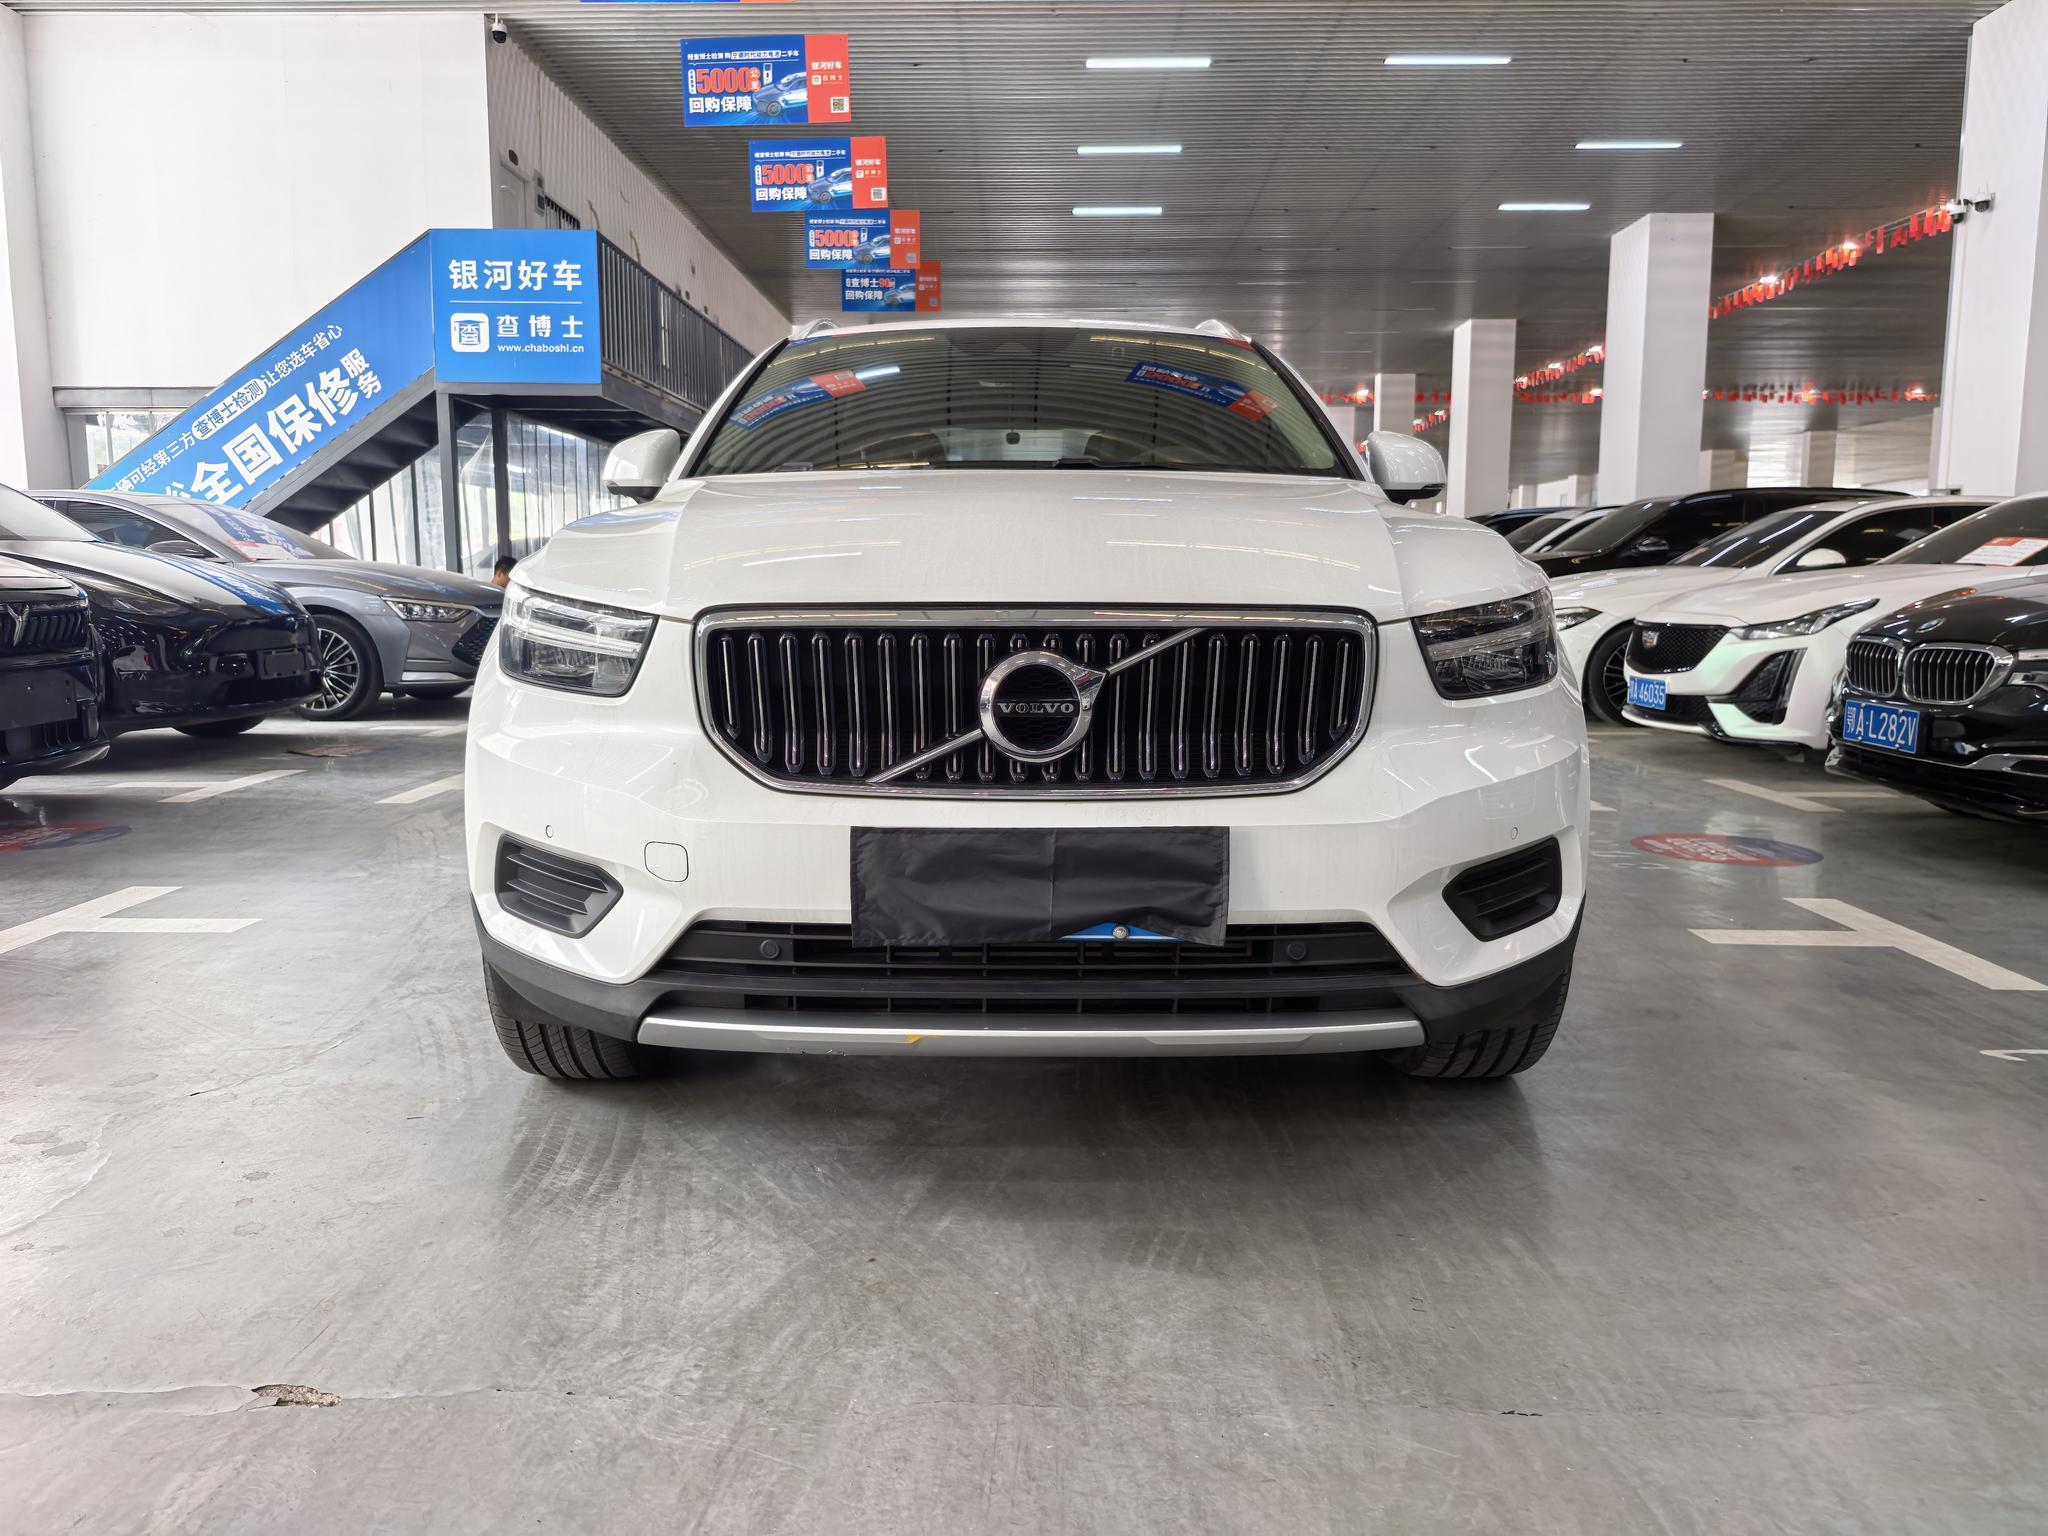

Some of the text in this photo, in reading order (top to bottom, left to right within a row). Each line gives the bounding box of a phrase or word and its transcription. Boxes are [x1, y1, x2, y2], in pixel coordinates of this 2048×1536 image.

[696, 67, 752, 94] 5000
[689, 96, 752, 113] 回购保障
[755, 187, 808, 201] 回购保障
[448, 259, 583, 291] 银河好车
[496, 315, 584, 338] 查博士
[497, 344, 585, 353] www.chaboshi.cn
[997, 702, 1075, 714] VOLVO
